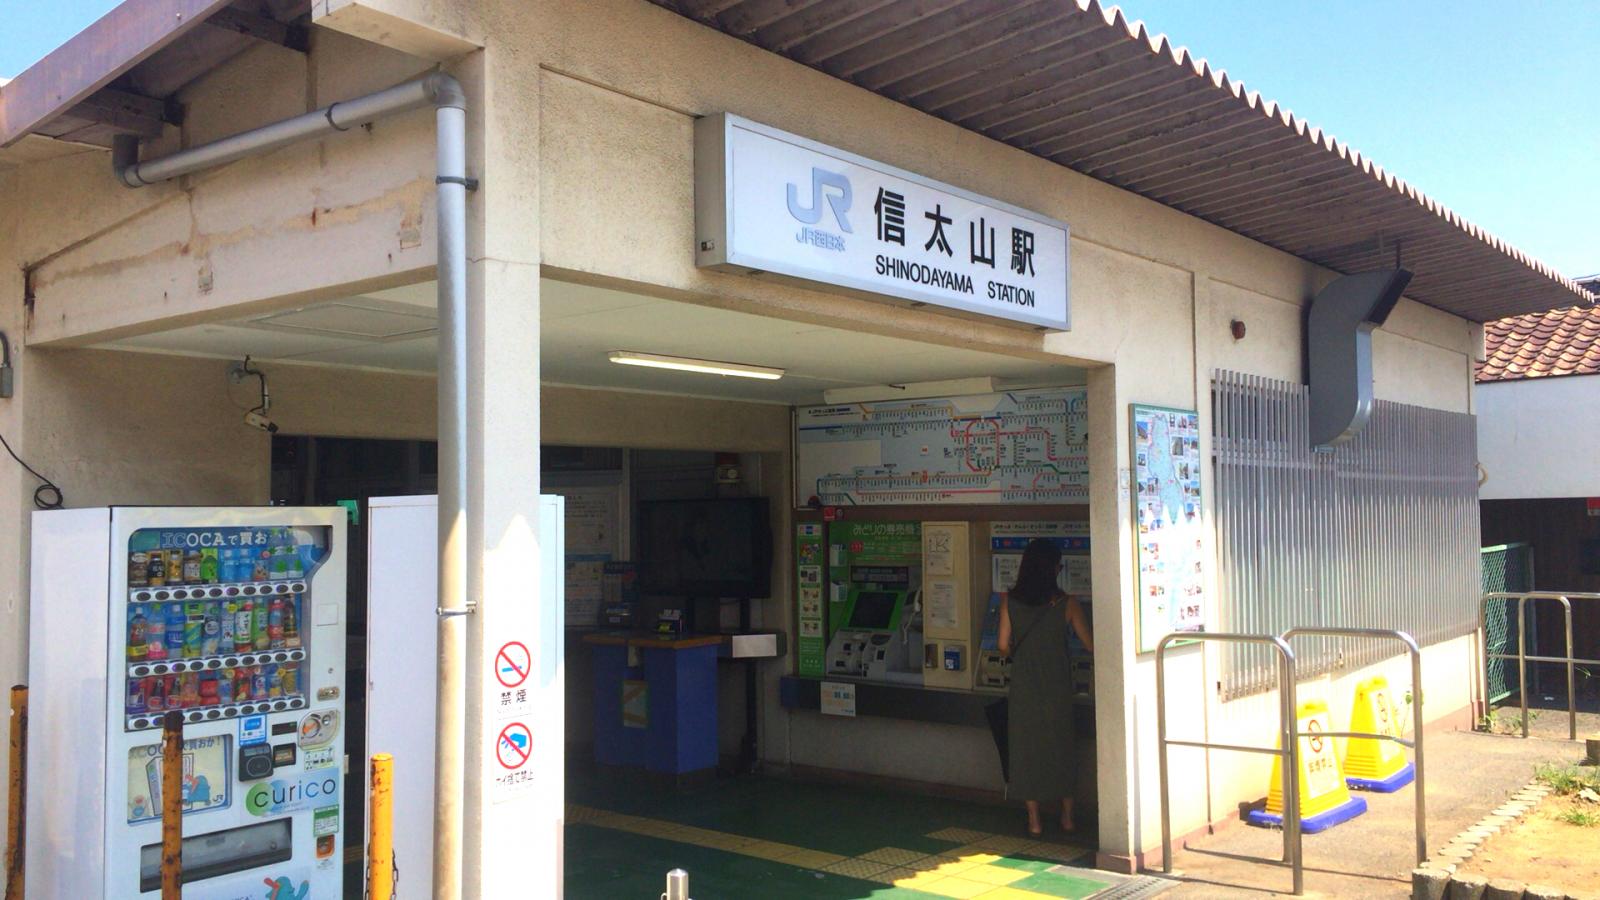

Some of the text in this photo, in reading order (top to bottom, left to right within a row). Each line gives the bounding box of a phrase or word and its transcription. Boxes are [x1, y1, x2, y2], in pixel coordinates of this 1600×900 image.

[786, 167, 854, 233] JR
[796, 226, 846, 252] JR西日本
[874, 187, 1035, 278] 信太山駅
[875, 254, 1035, 308] SHINODAYAMA STATION
[501, 689, 527, 706] 禁煙
[254, 778, 336, 808] curico
[496, 770, 534, 786] イ捨て禁止
